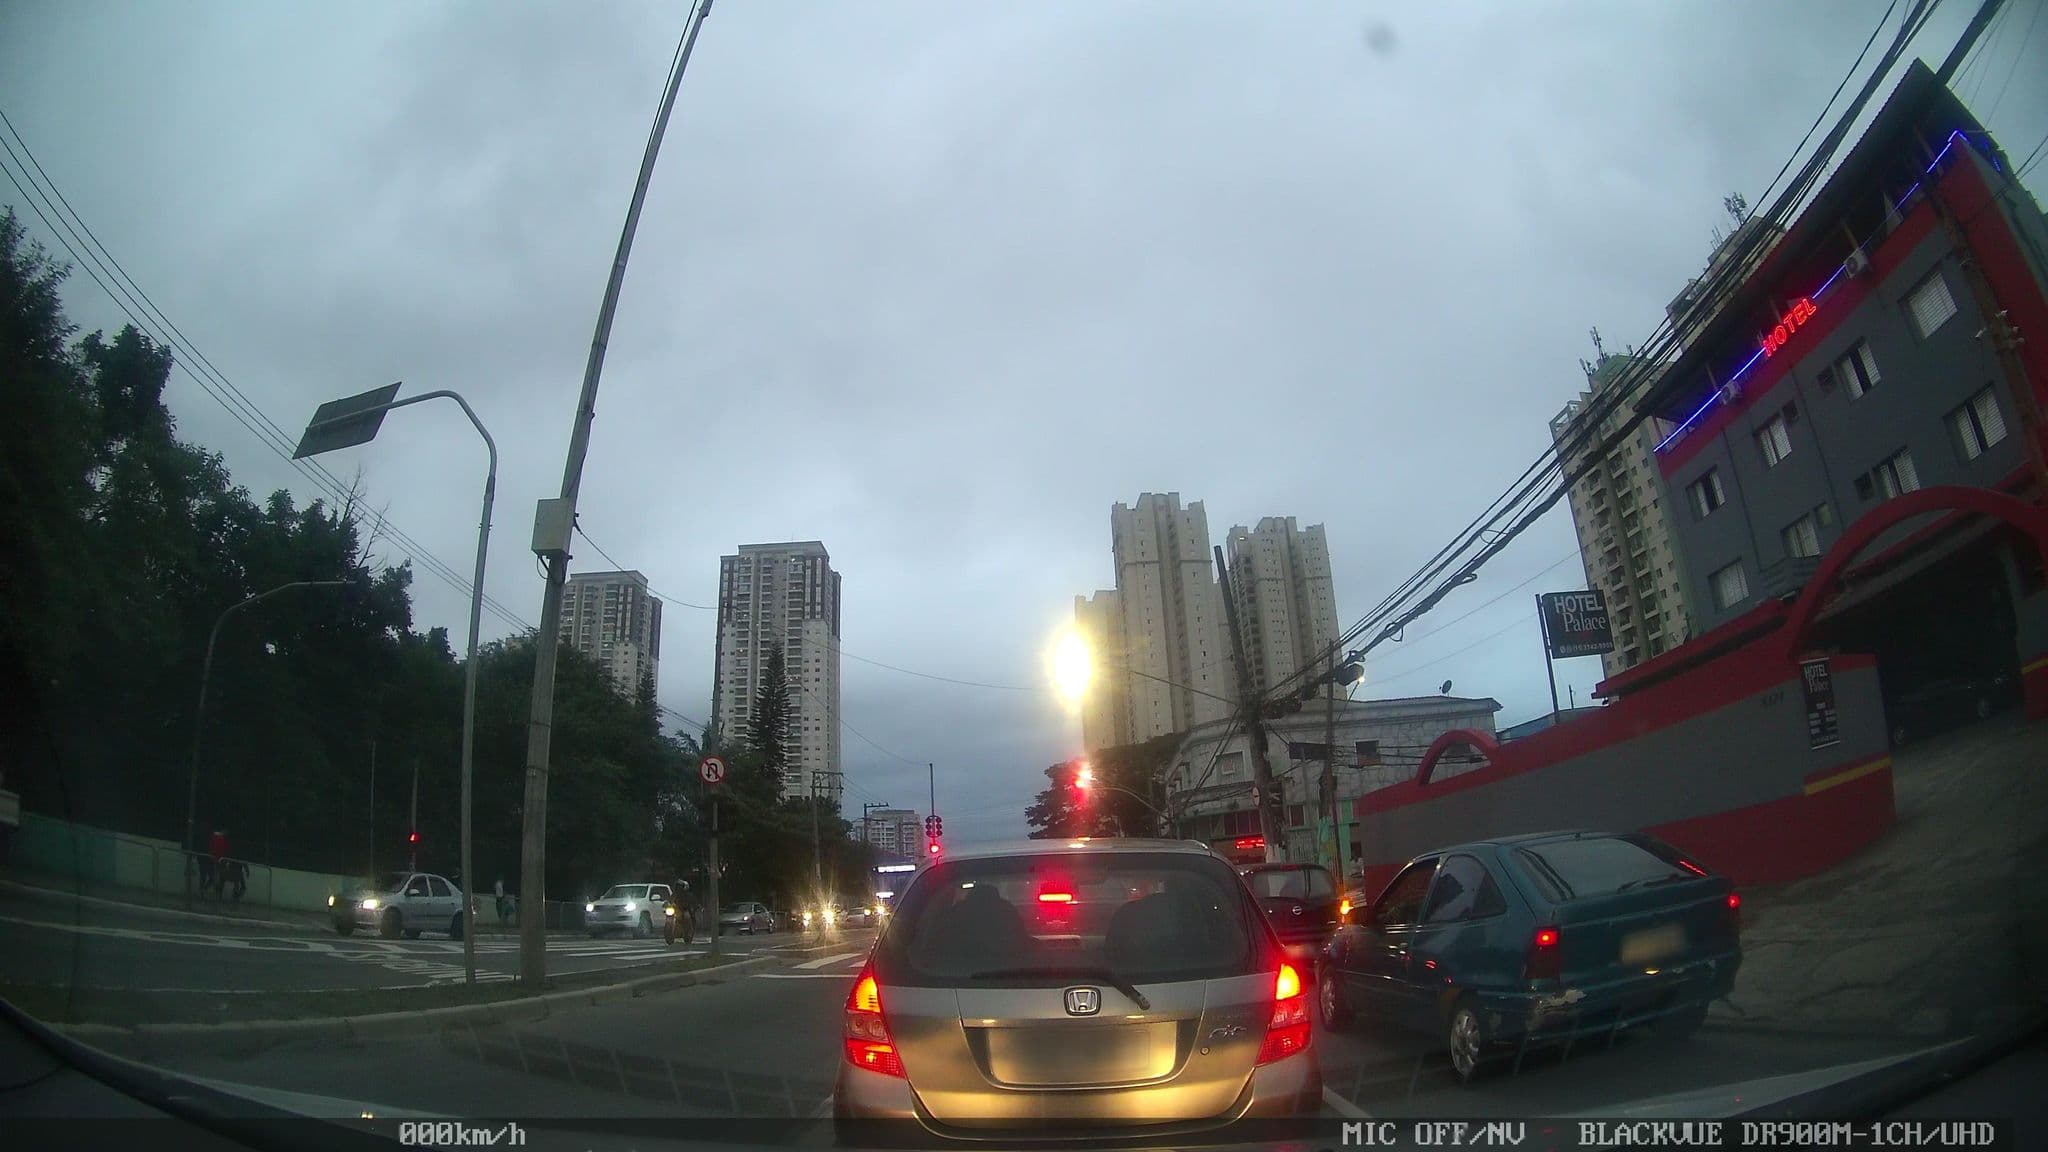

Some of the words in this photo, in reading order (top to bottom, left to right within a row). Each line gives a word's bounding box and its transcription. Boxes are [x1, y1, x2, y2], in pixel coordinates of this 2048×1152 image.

[1763, 298, 1817, 357] HOTEL
[1554, 594, 1603, 613] HOTEL
[1562, 612, 1606, 632] Palace
[1803, 664, 1828, 680] HOTEL
